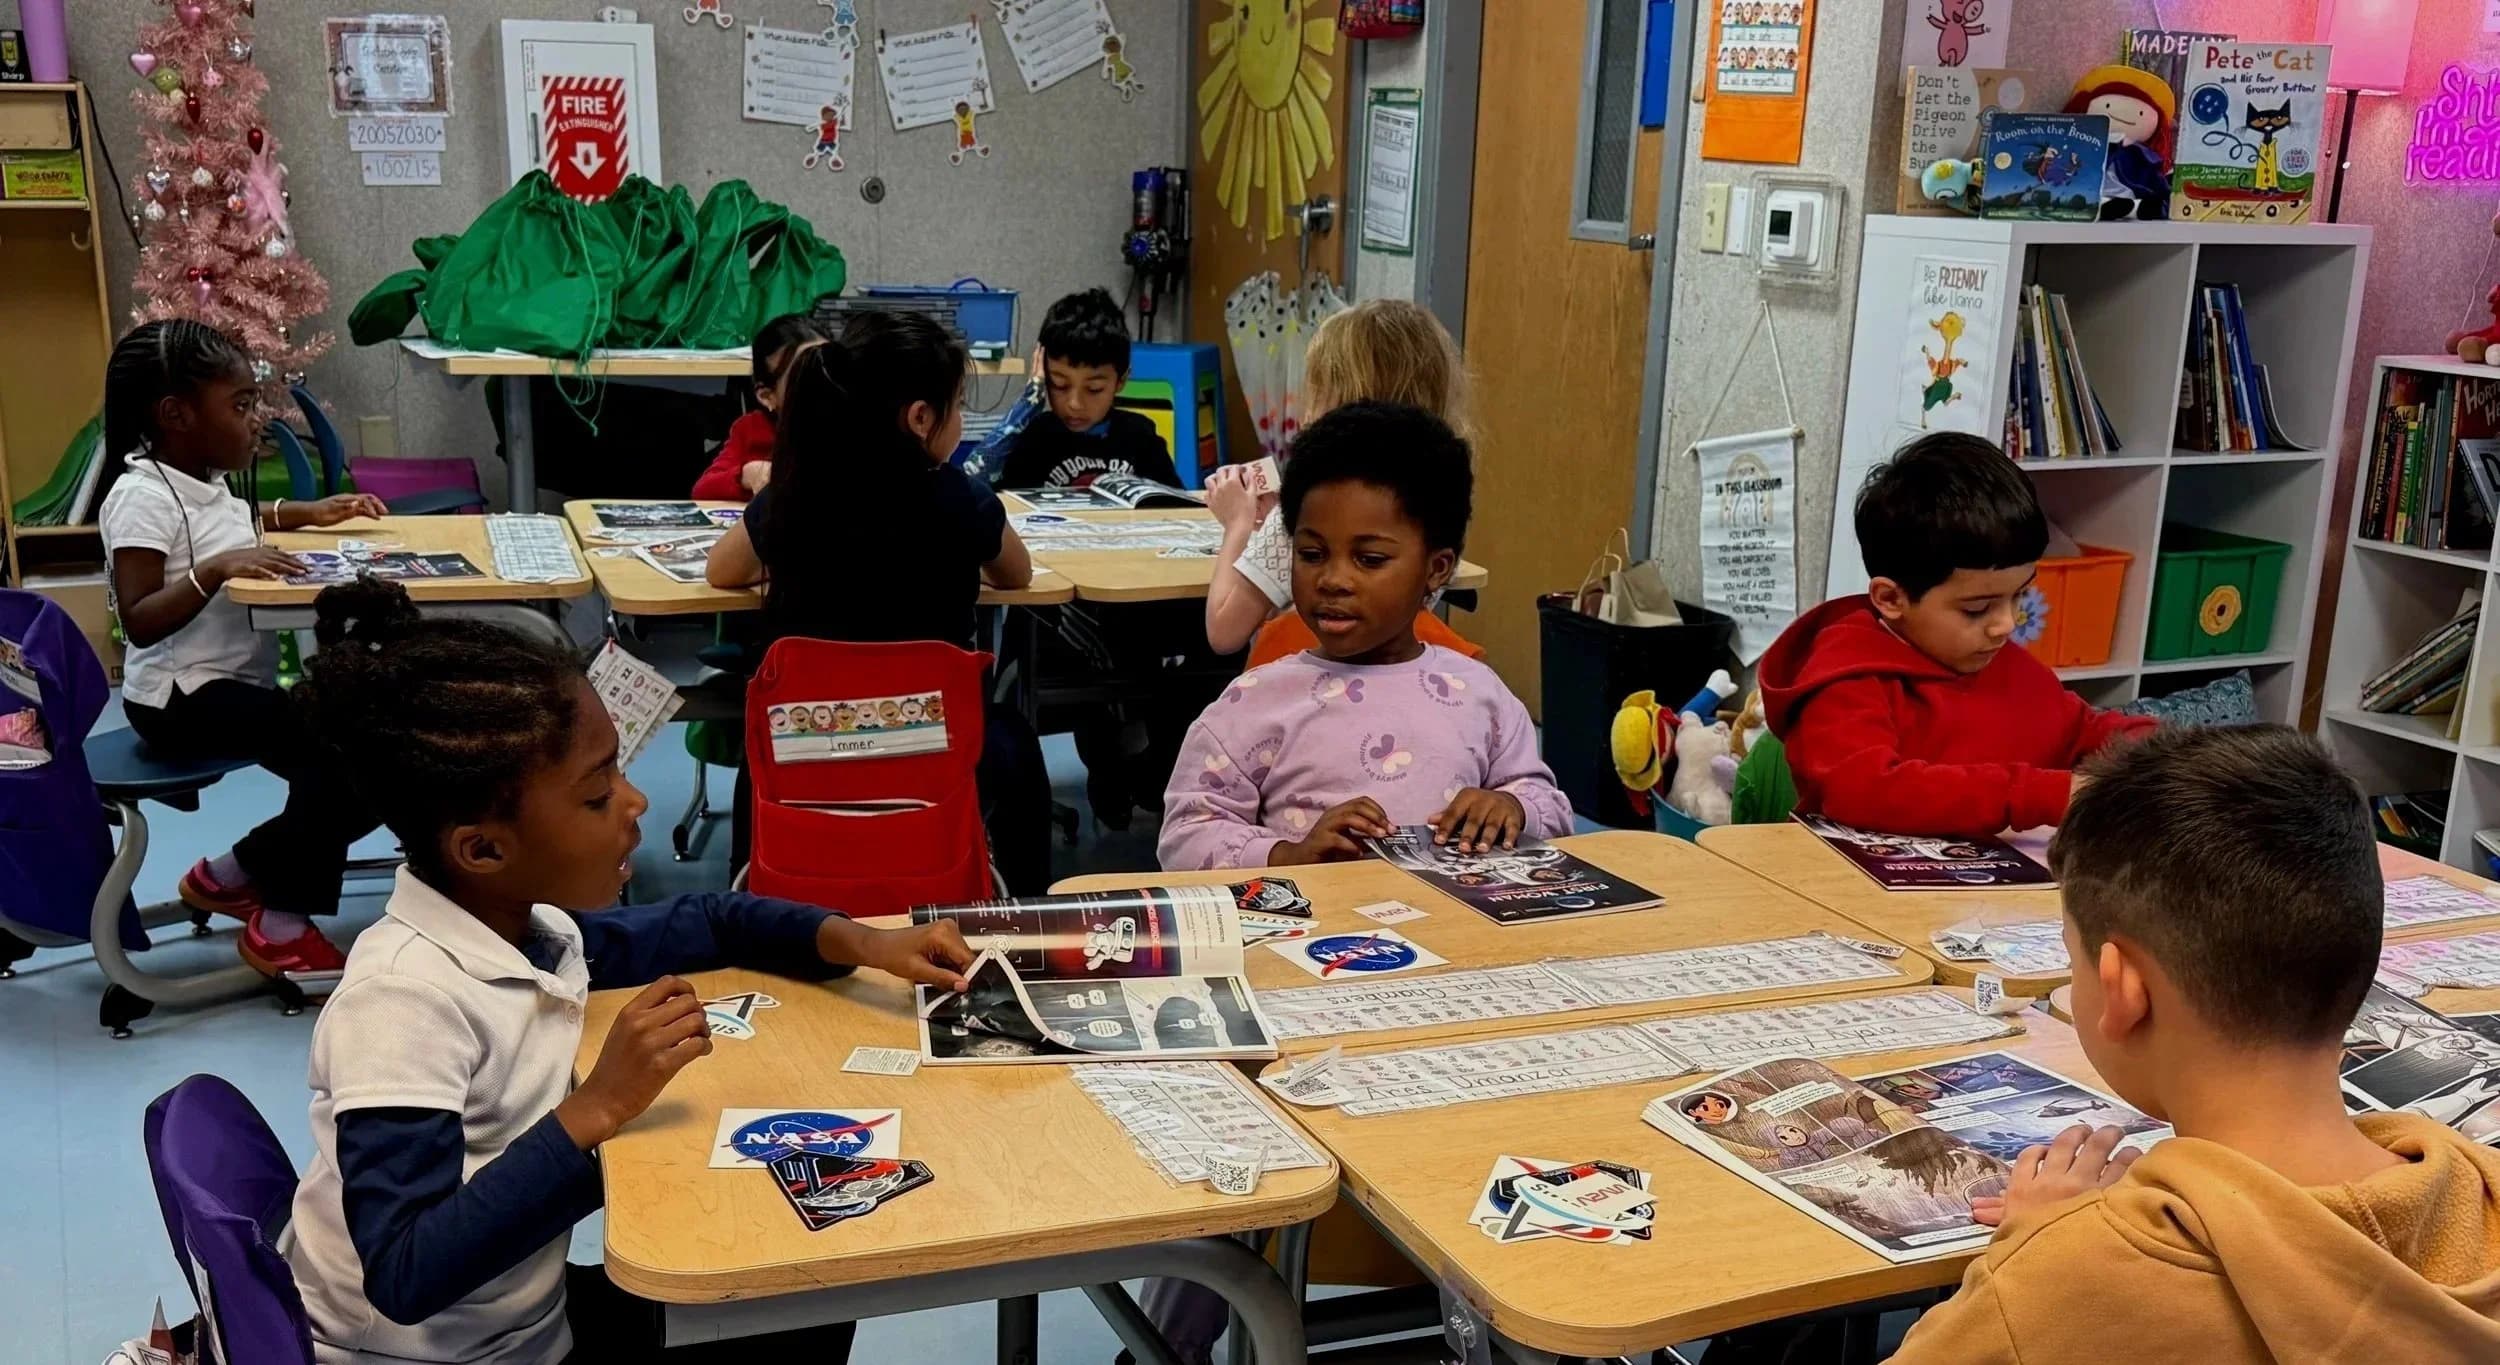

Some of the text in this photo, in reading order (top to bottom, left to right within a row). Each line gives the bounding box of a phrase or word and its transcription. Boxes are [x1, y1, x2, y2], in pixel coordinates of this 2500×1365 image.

[2131, 34, 2237, 56] MADE
[2205, 46, 2316, 71] Pete the Cat
[1, 71, 25, 81] Sharp
[1916, 75, 1960, 89] Don't
[2220, 71, 2275, 84] and His Four
[1915, 91, 1972, 105] Let the
[2245, 82, 2316, 95] Groovy Buttons
[561, 95, 608, 115] FIRE
[1914, 107, 1967, 123] Pigeon
[558, 117, 615, 134] EXTINGUISHER
[1912, 124, 1957, 137] Drive
[1995, 123, 2102, 147] Room on the Broom
[2414, 106, 2463, 147] I'm
[1911, 140, 1937, 153] the
[1923, 265, 1988, 292] Be FRIENDLY
[2463, 377, 2500, 415] HORT
[1487, 882, 1609, 903] FIRST WOMAN
[1315, 943, 1404, 962] NASA
[1327, 986, 1447, 1007] Chambers
[1448, 1065, 1573, 1090] Umanzor
[743, 1131, 864, 1145] NASA
